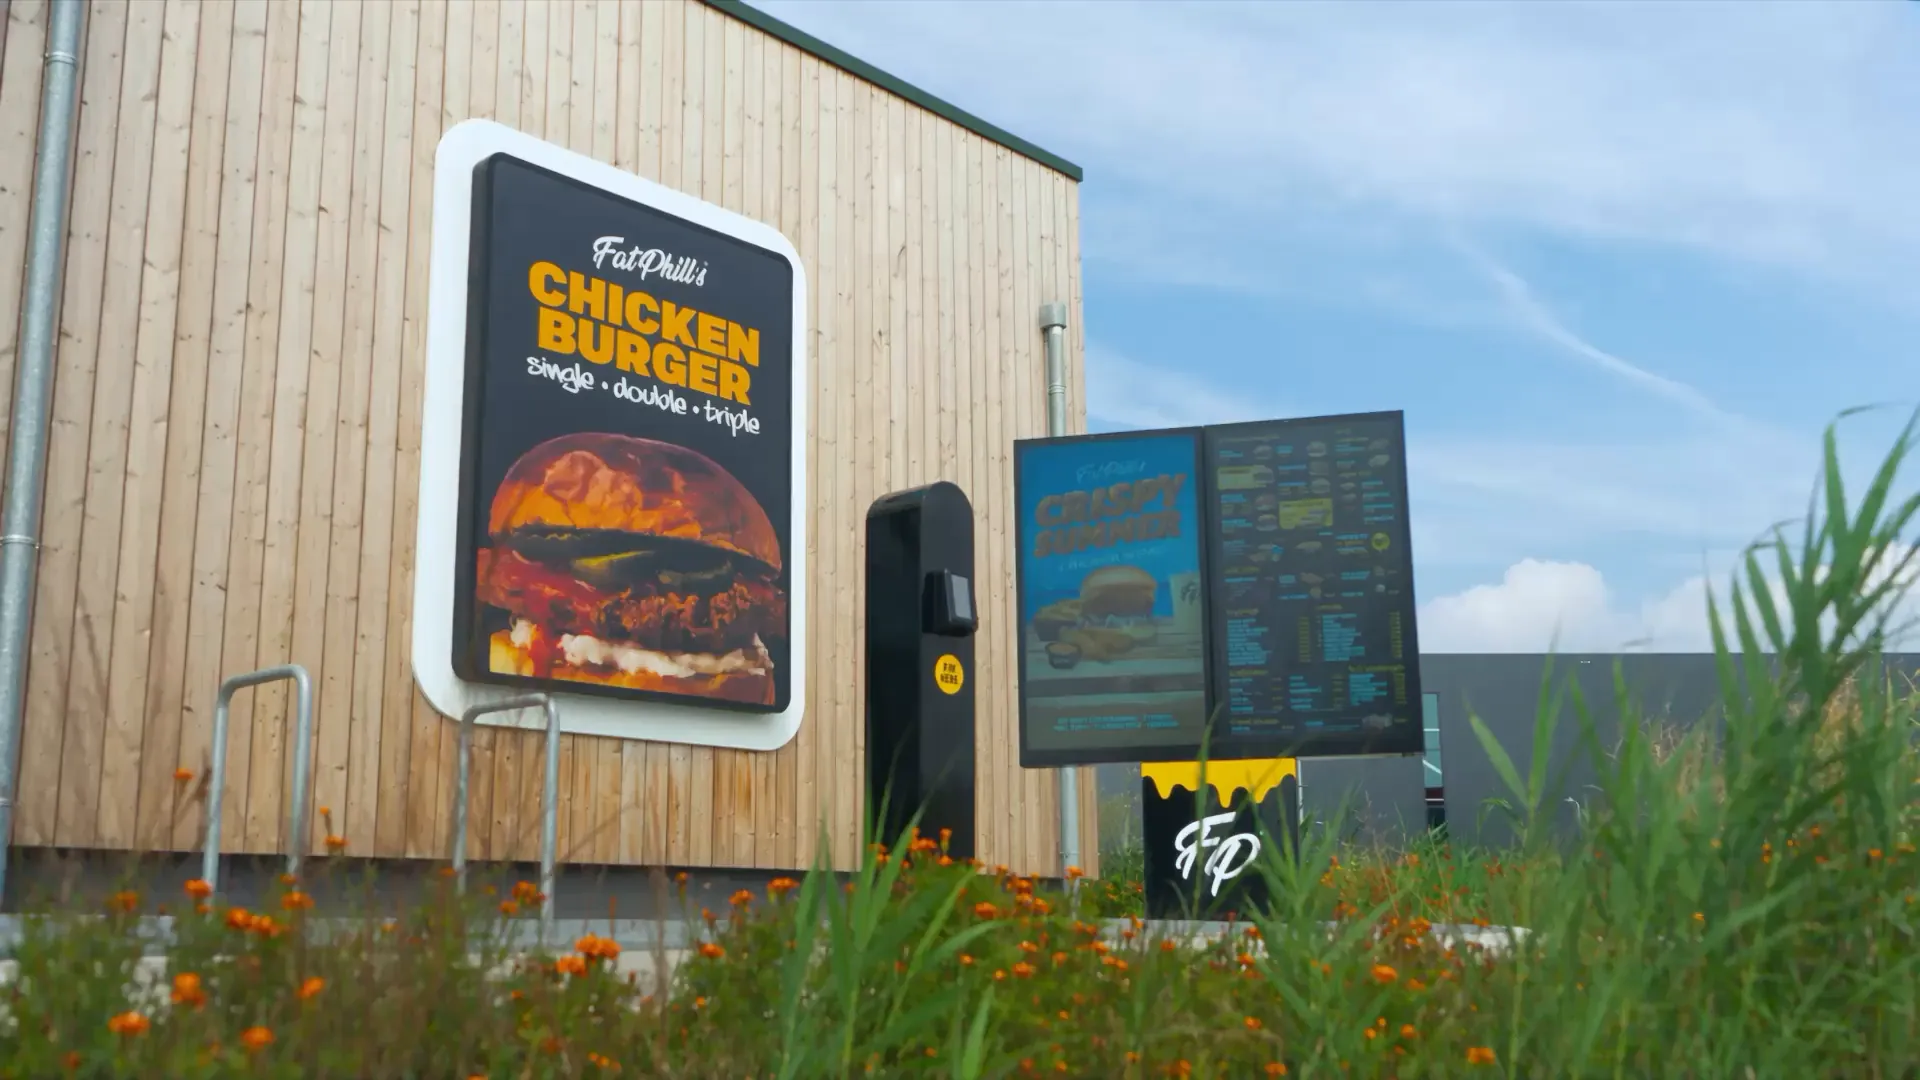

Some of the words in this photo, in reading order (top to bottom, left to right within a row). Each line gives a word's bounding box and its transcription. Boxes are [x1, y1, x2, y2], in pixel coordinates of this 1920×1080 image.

[529, 261, 760, 367] CHICKEN
[538, 306, 751, 406] BURGER
[526, 356, 594, 394] single
[613, 376, 687, 415] double
[703, 400, 760, 437] triple
[1035, 472, 1187, 527] CRISPY
